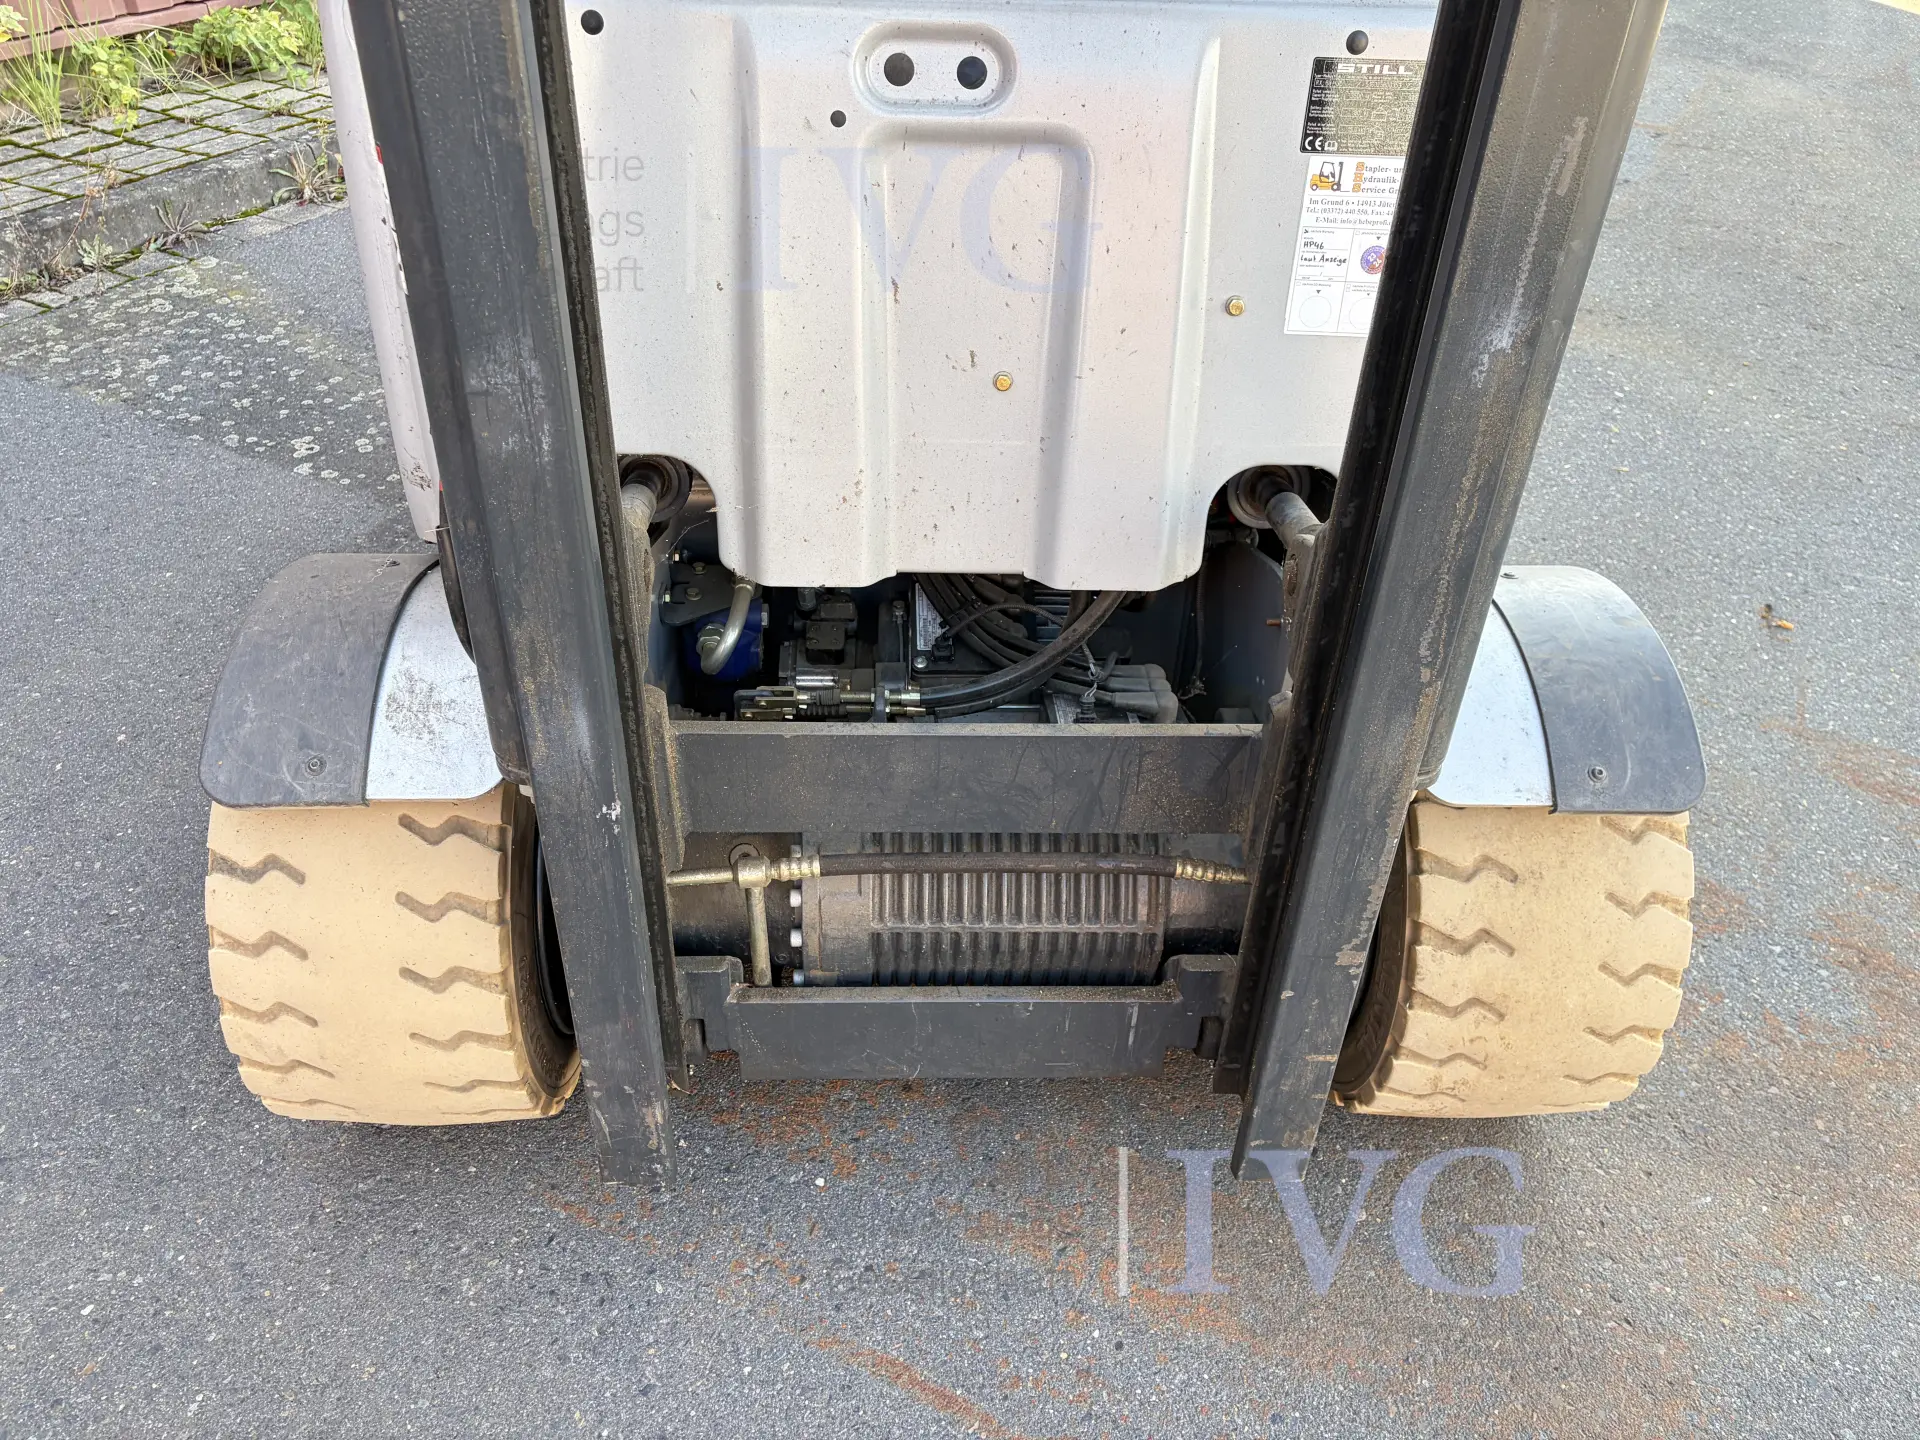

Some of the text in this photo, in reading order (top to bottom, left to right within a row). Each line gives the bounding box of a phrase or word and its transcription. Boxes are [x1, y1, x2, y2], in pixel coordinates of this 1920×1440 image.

[1336, 63, 1412, 75] STILL
[1352, 183, 1386, 194] Service
[1320, 198, 1344, 206] Grund
